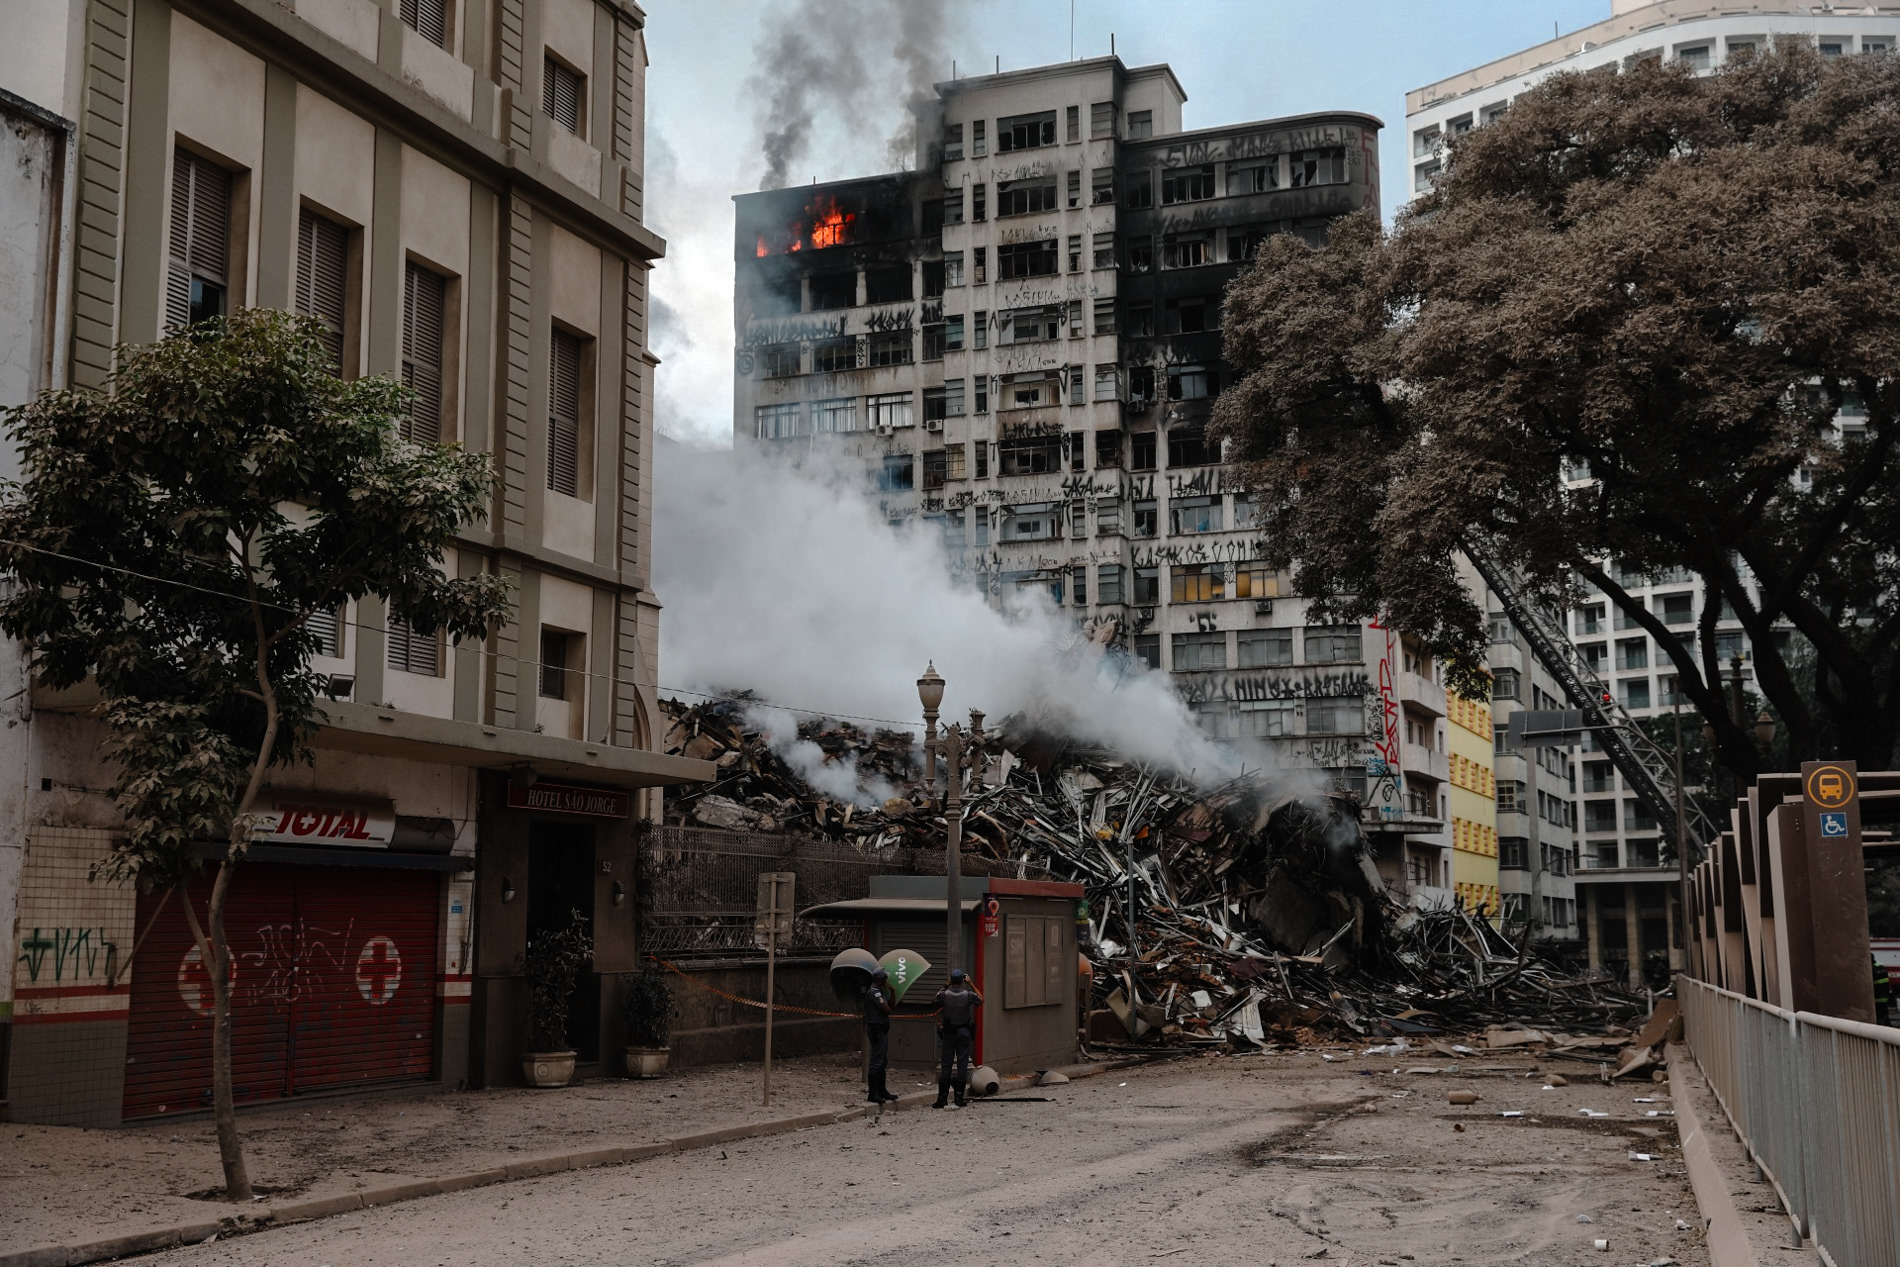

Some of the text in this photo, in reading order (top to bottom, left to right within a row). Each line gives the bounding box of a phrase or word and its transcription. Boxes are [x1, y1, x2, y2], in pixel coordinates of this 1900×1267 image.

[527, 789, 561, 808] HOTEL
[585, 796, 617, 813] JORGE
[275, 803, 371, 840] TOTAL
[602, 861, 612, 872] 52
[895, 956, 908, 985] vivo
